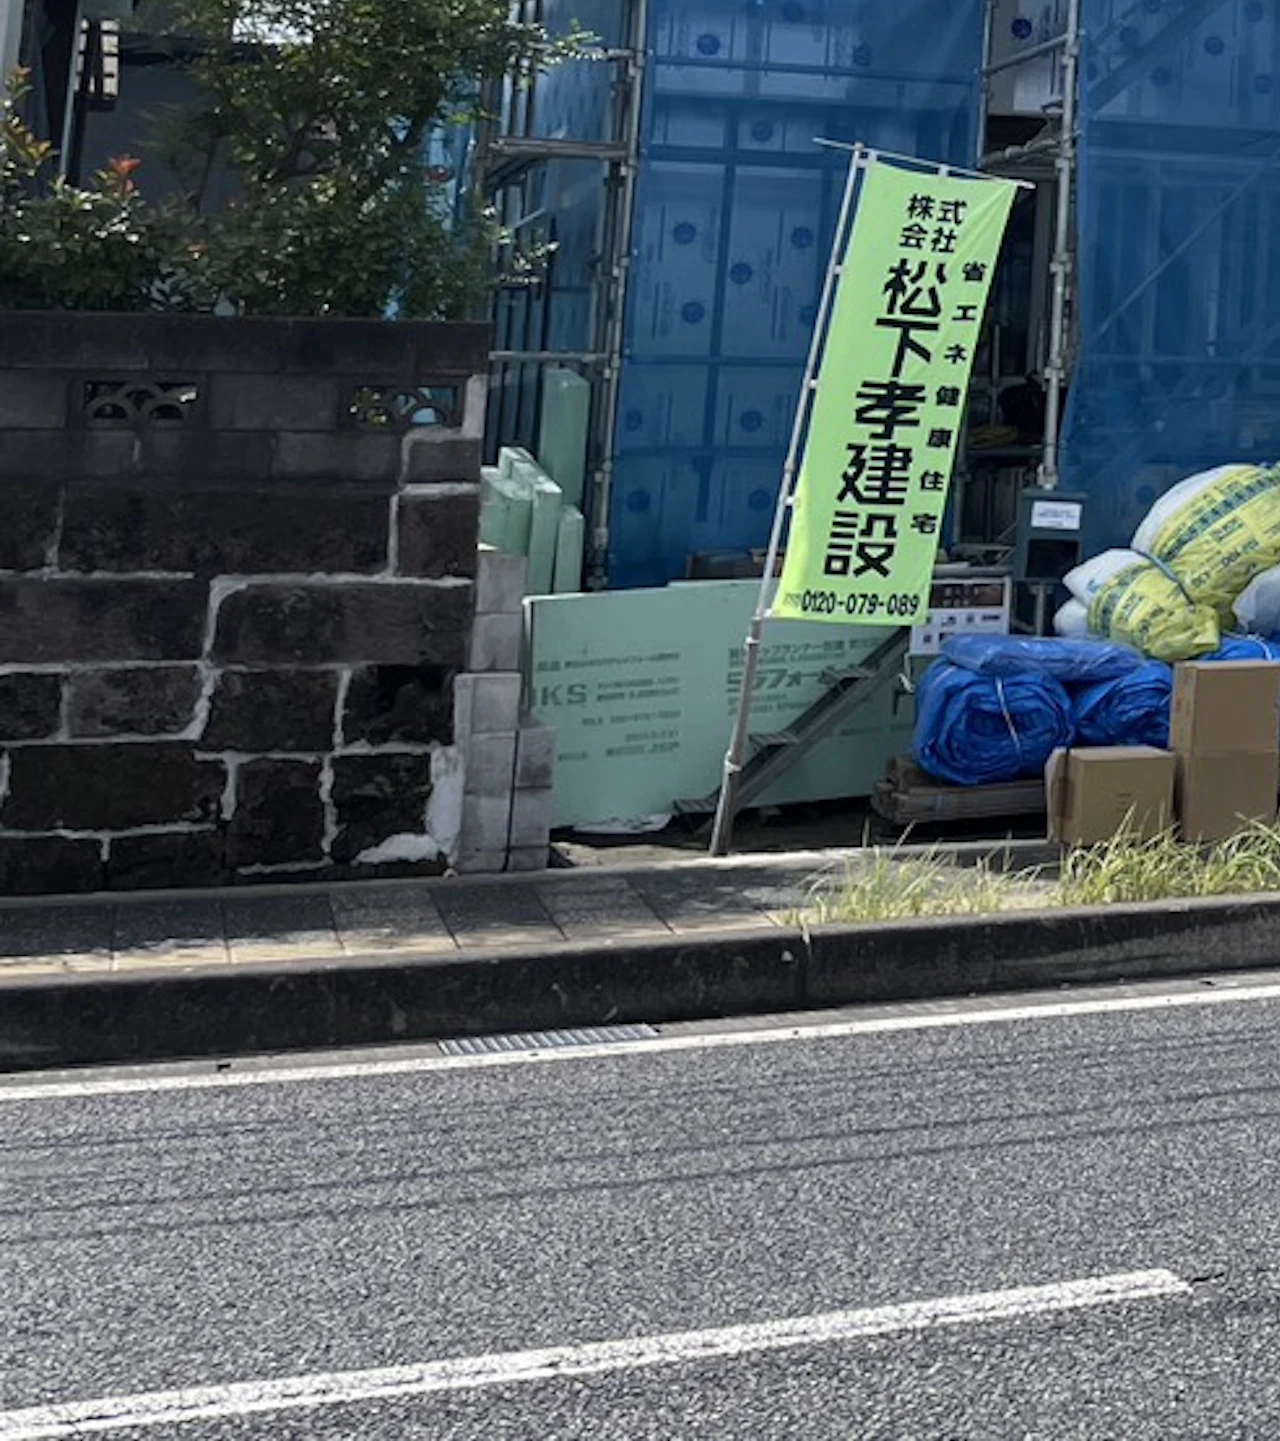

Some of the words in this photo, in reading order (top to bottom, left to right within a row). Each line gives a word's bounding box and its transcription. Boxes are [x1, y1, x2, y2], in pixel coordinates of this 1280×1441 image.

[907, 193, 967, 226] 株式
[898, 222, 957, 254] 会社
[910, 261, 988, 535] 省エネ健康住宅
[824, 258, 947, 578] 松下孝建設
[801, 588, 920, 617] 0120-079-089
